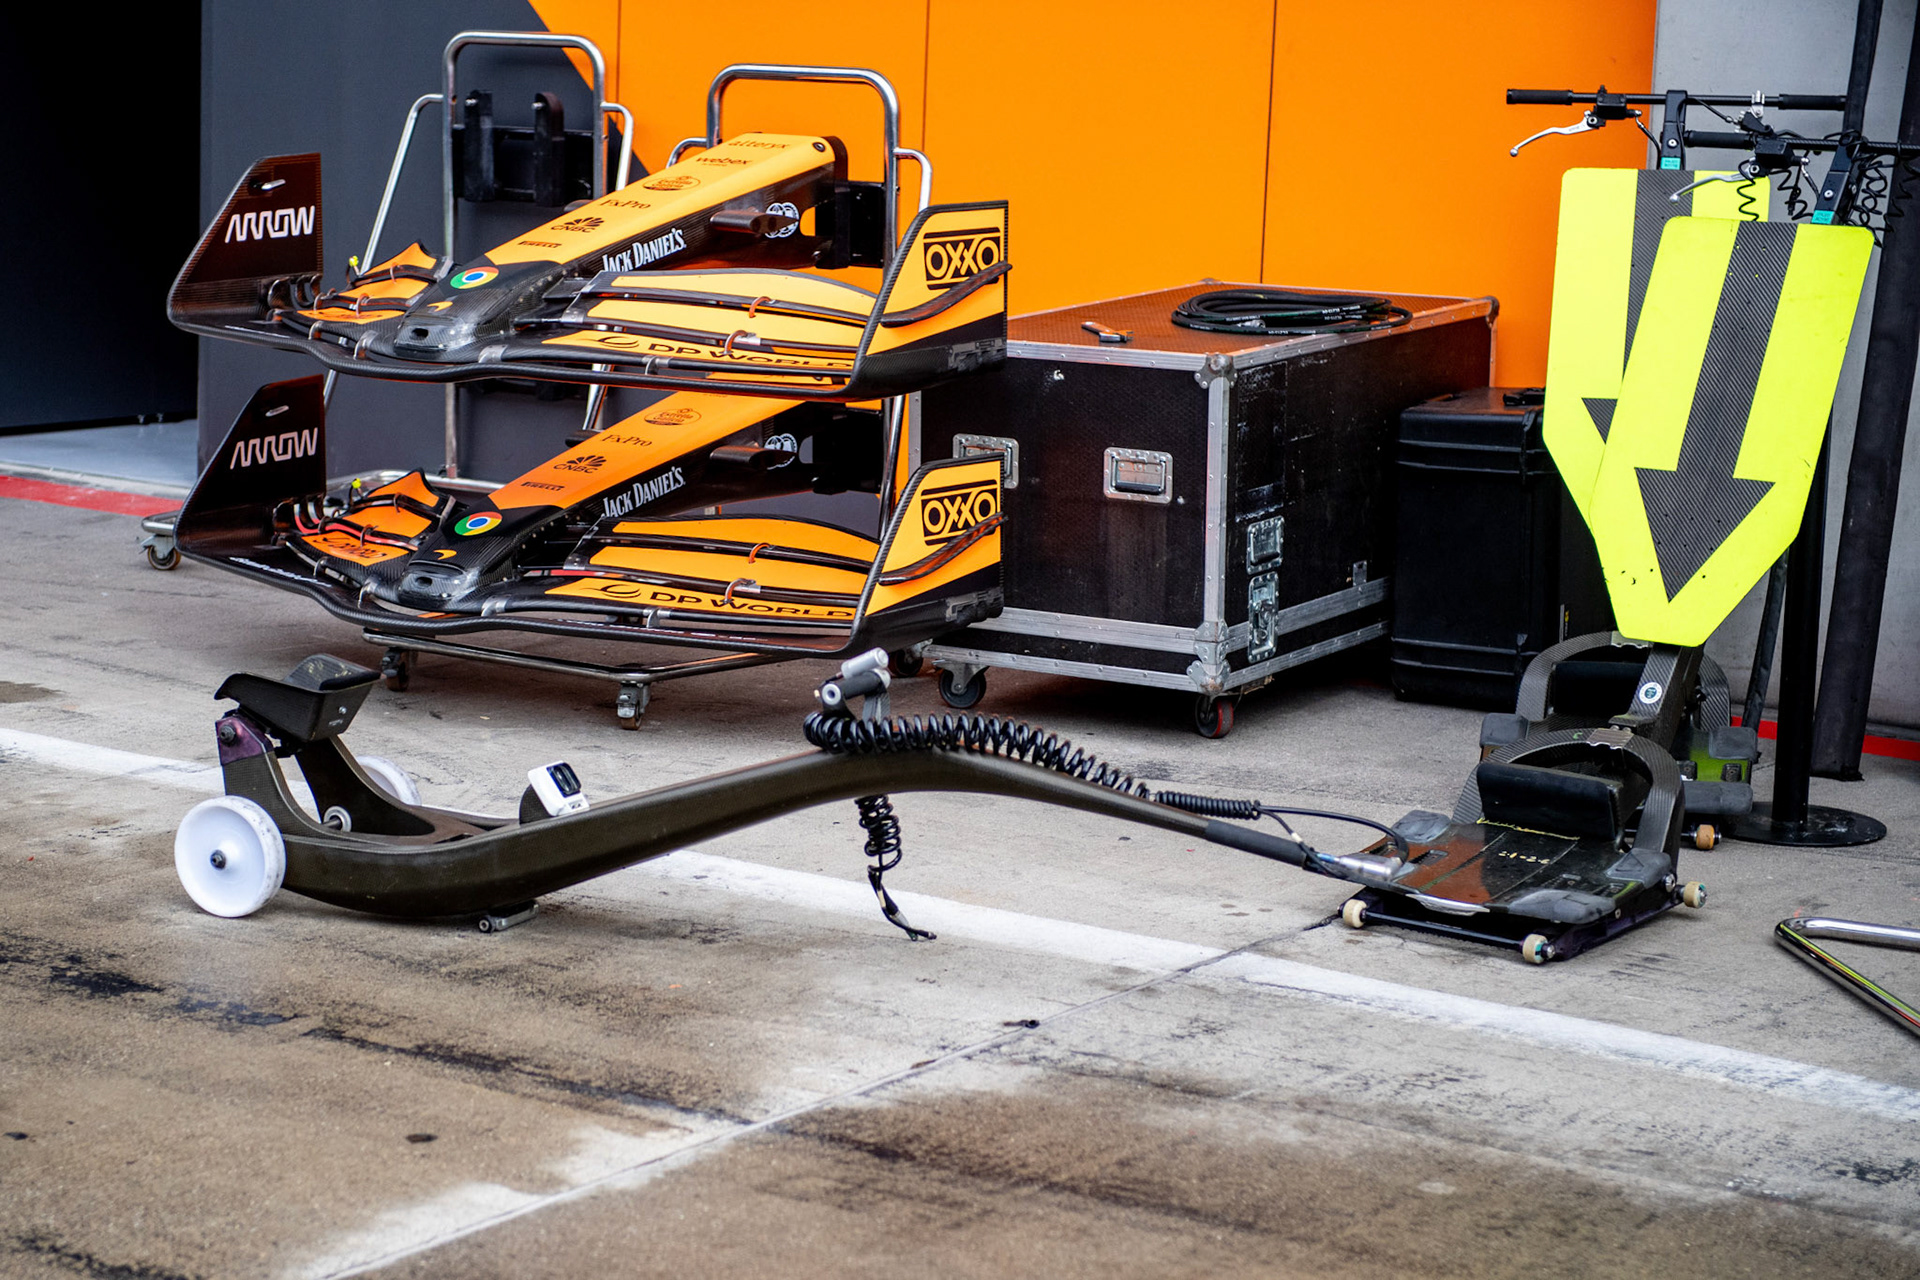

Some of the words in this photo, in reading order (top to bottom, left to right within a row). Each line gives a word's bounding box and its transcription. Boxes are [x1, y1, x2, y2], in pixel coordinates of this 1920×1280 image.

[728, 139, 791, 150] alteryx
[696, 156, 752, 165] webex
[600, 199, 651, 209] FxPro
[225, 205, 316, 243] ARROW
[551, 225, 596, 234] CNBC
[602, 248, 634, 272] JACK
[631, 227, 687, 268] DANIEL'S
[925, 238, 999, 281] OXXO
[648, 343, 701, 355] DP
[709, 349, 853, 368] WORLD
[229, 427, 318, 470] ARROW
[602, 434, 652, 447] FxPro
[553, 463, 599, 474] CNBC
[600, 490, 633, 519] JACK
[632, 466, 686, 508] DANIEL'S
[923, 491, 997, 534] OXXO
[650, 591, 702, 604] DP
[710, 597, 853, 617] WORLD
